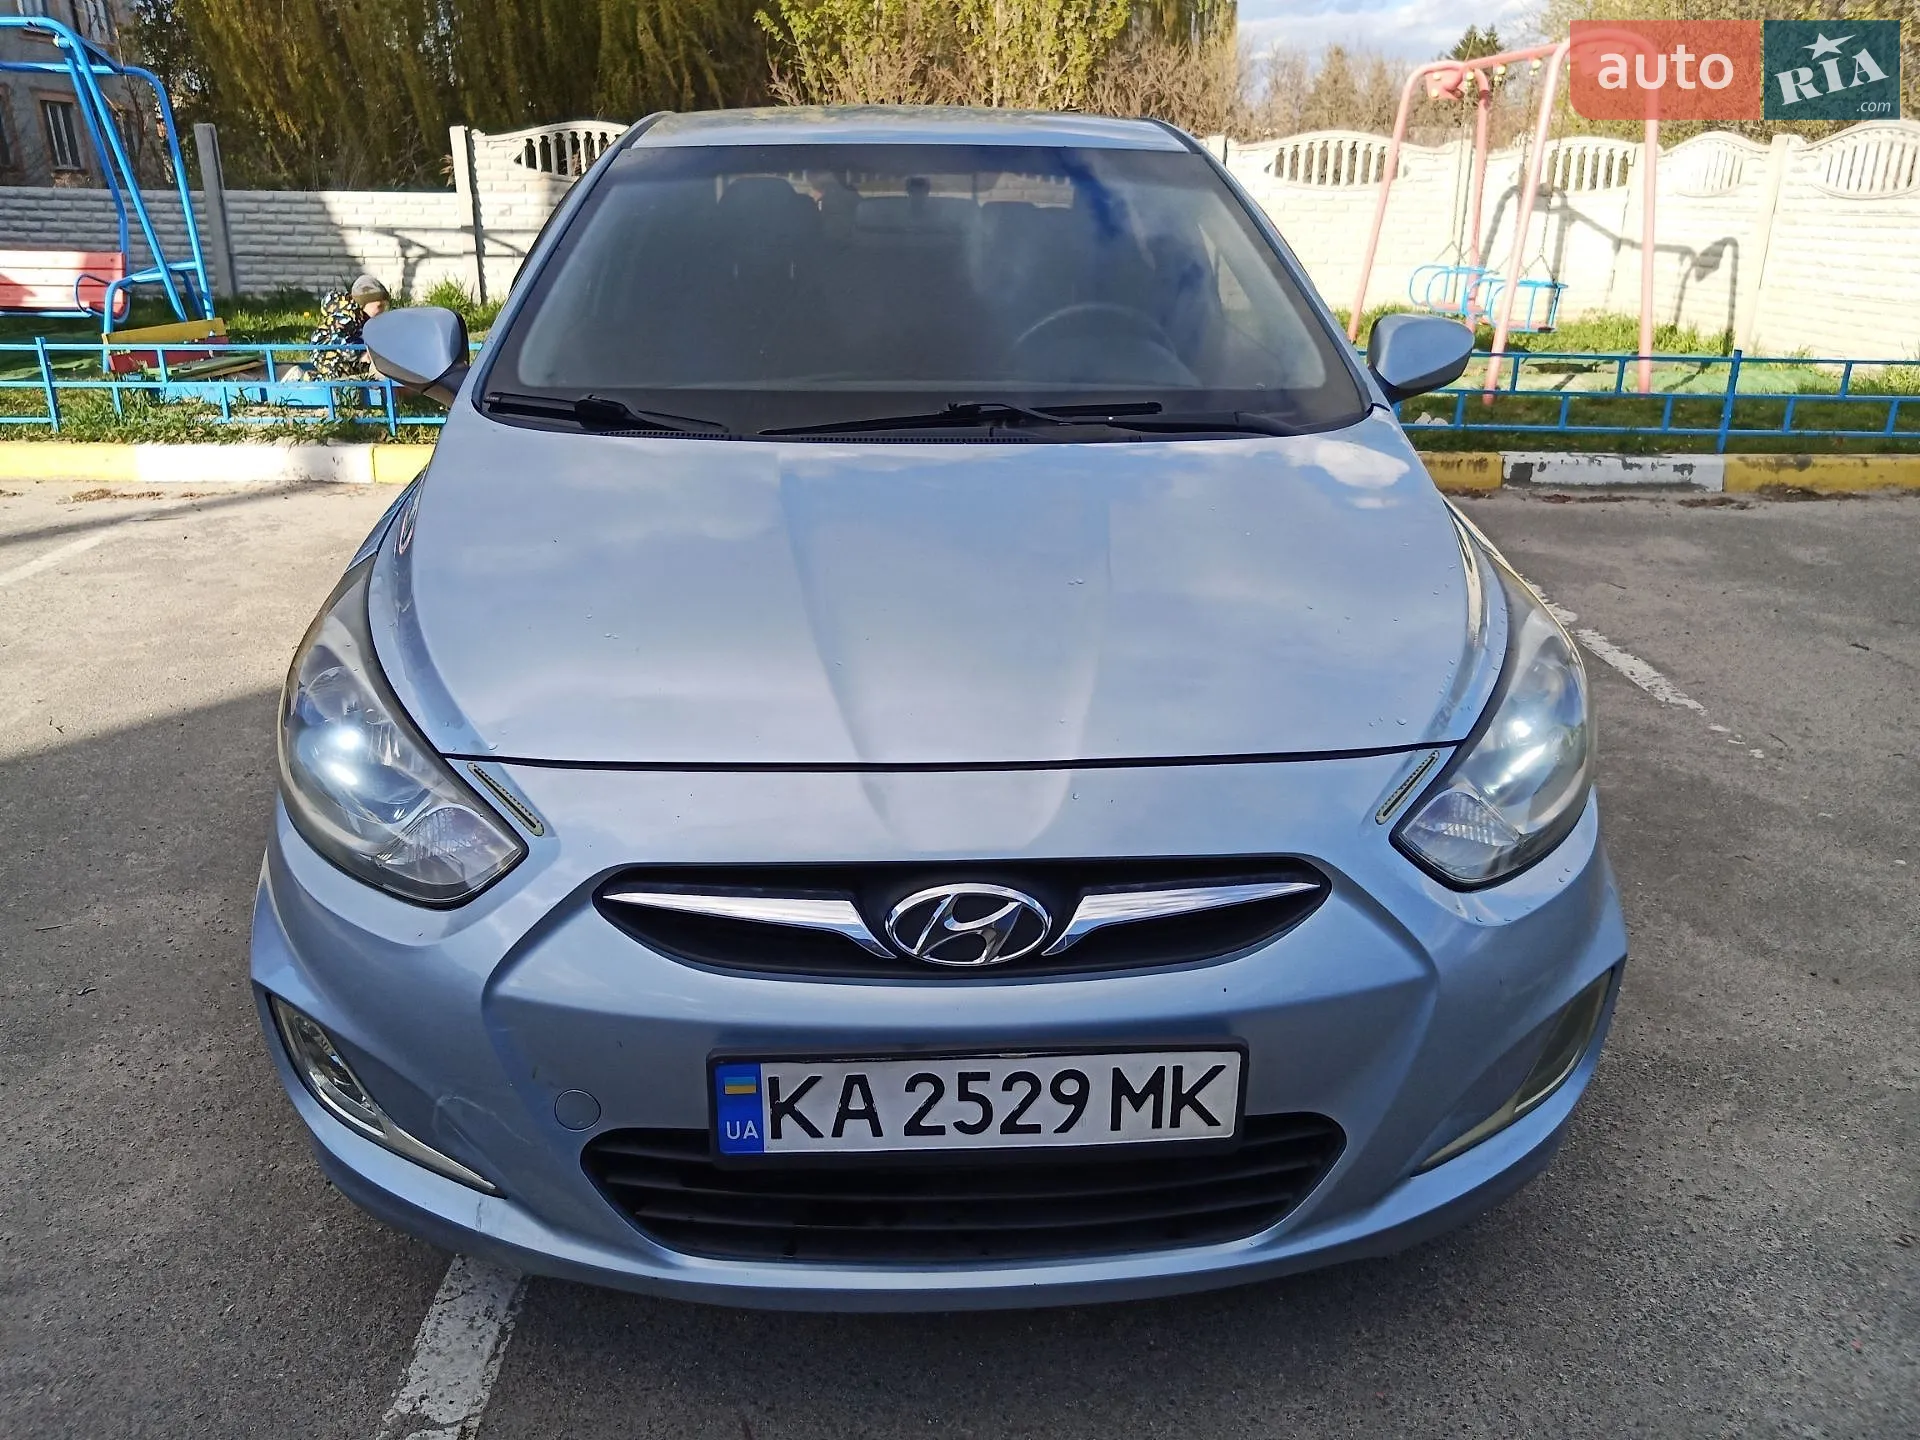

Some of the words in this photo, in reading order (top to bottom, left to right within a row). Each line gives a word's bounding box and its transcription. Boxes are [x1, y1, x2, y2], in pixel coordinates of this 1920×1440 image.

[768, 1074, 884, 1140] KA
[903, 1068, 1091, 1138] 2529
[1110, 1064, 1227, 1132] MK
[726, 1121, 759, 1140] UA
